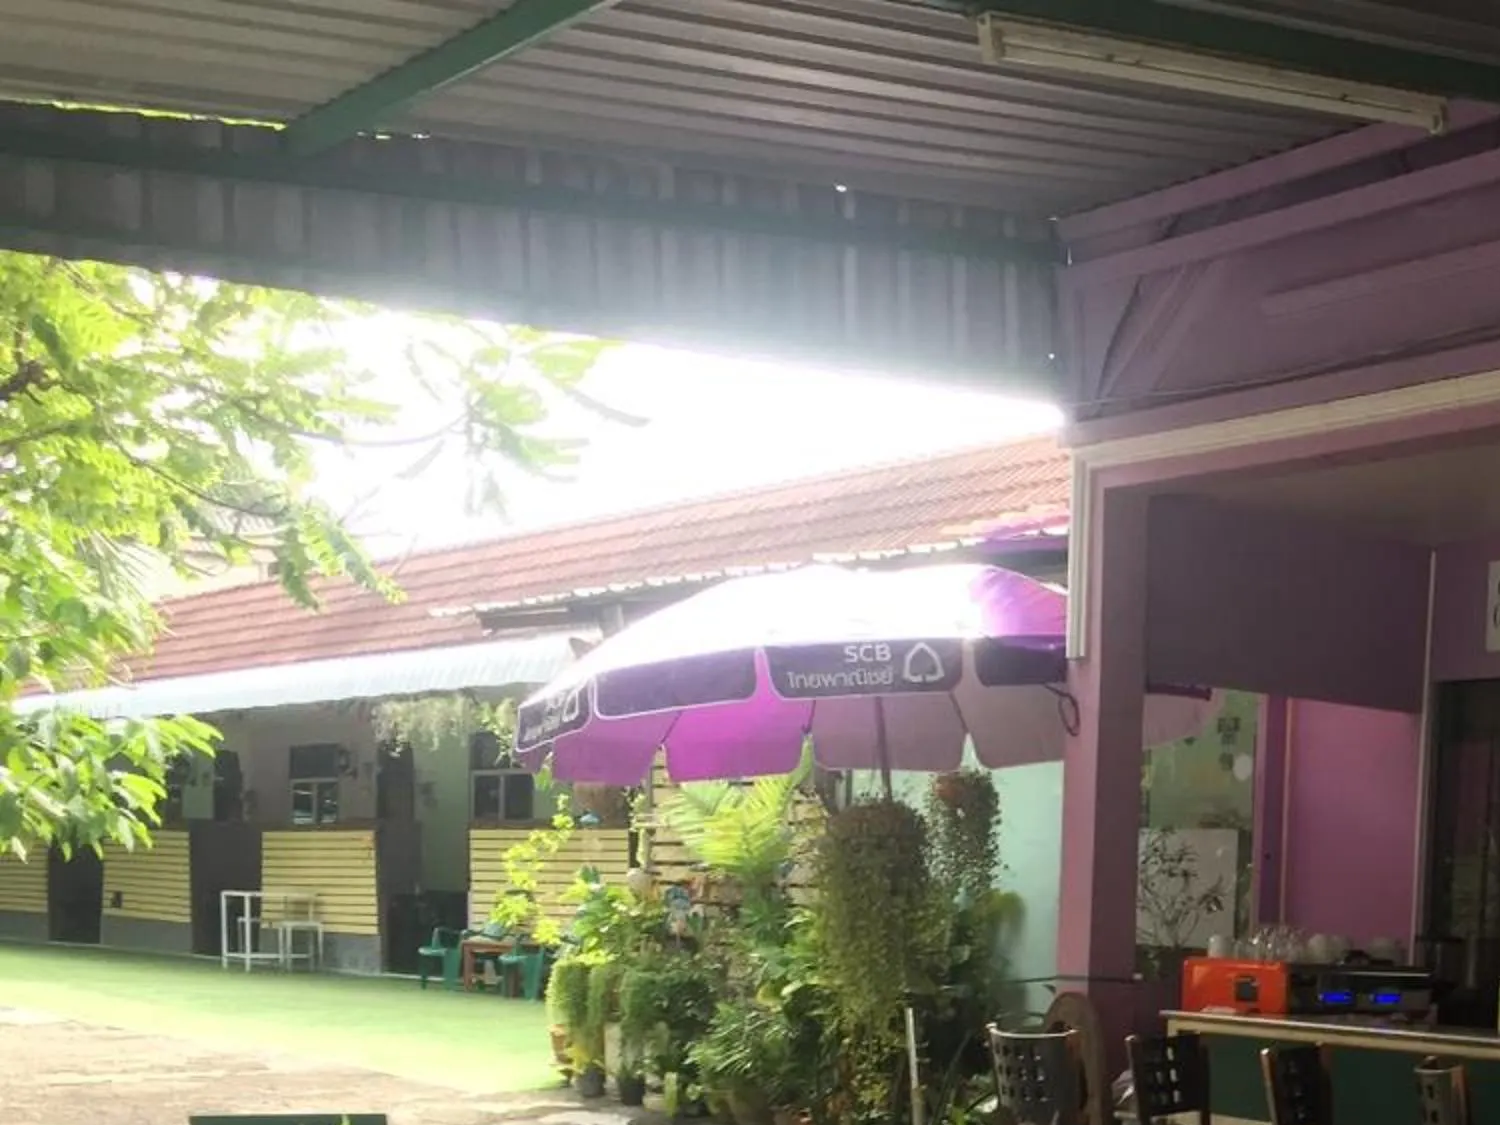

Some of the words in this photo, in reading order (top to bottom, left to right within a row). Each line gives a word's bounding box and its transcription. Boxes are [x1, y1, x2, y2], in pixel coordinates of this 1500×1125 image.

[843, 641, 893, 663] SCB
[786, 666, 894, 689] ไทยพาณิชย์
